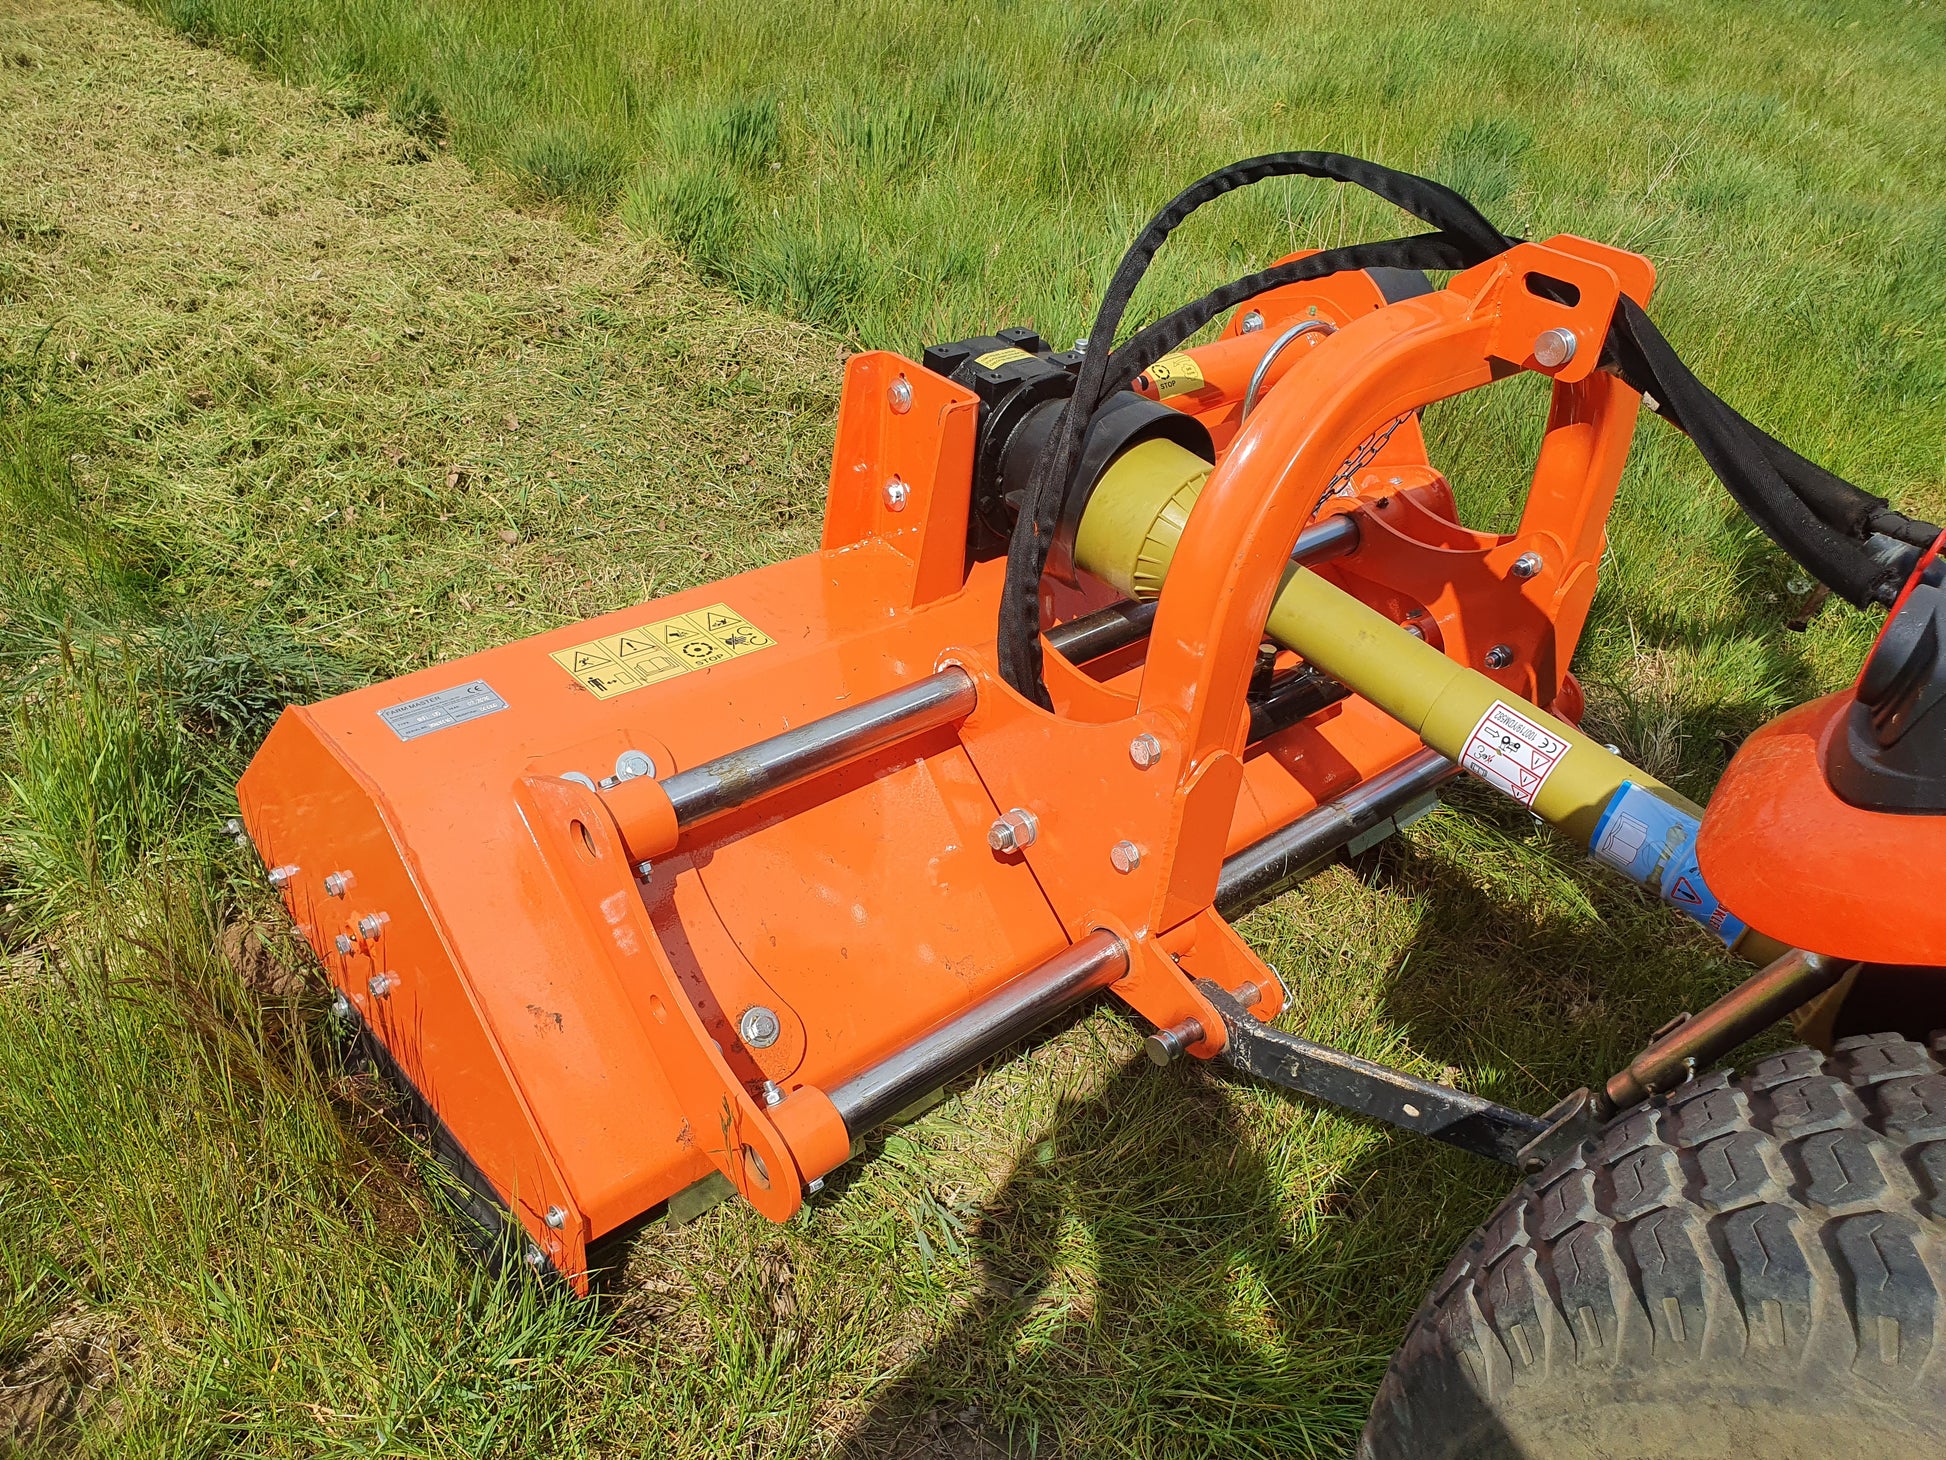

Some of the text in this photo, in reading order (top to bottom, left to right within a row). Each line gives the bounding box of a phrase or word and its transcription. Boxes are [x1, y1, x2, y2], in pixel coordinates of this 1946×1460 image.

[1160, 380, 1176, 390] STOP
[695, 654, 723, 665] STOP
[385, 705, 409, 716] FARM
[409, 696, 441, 708] MASTER
